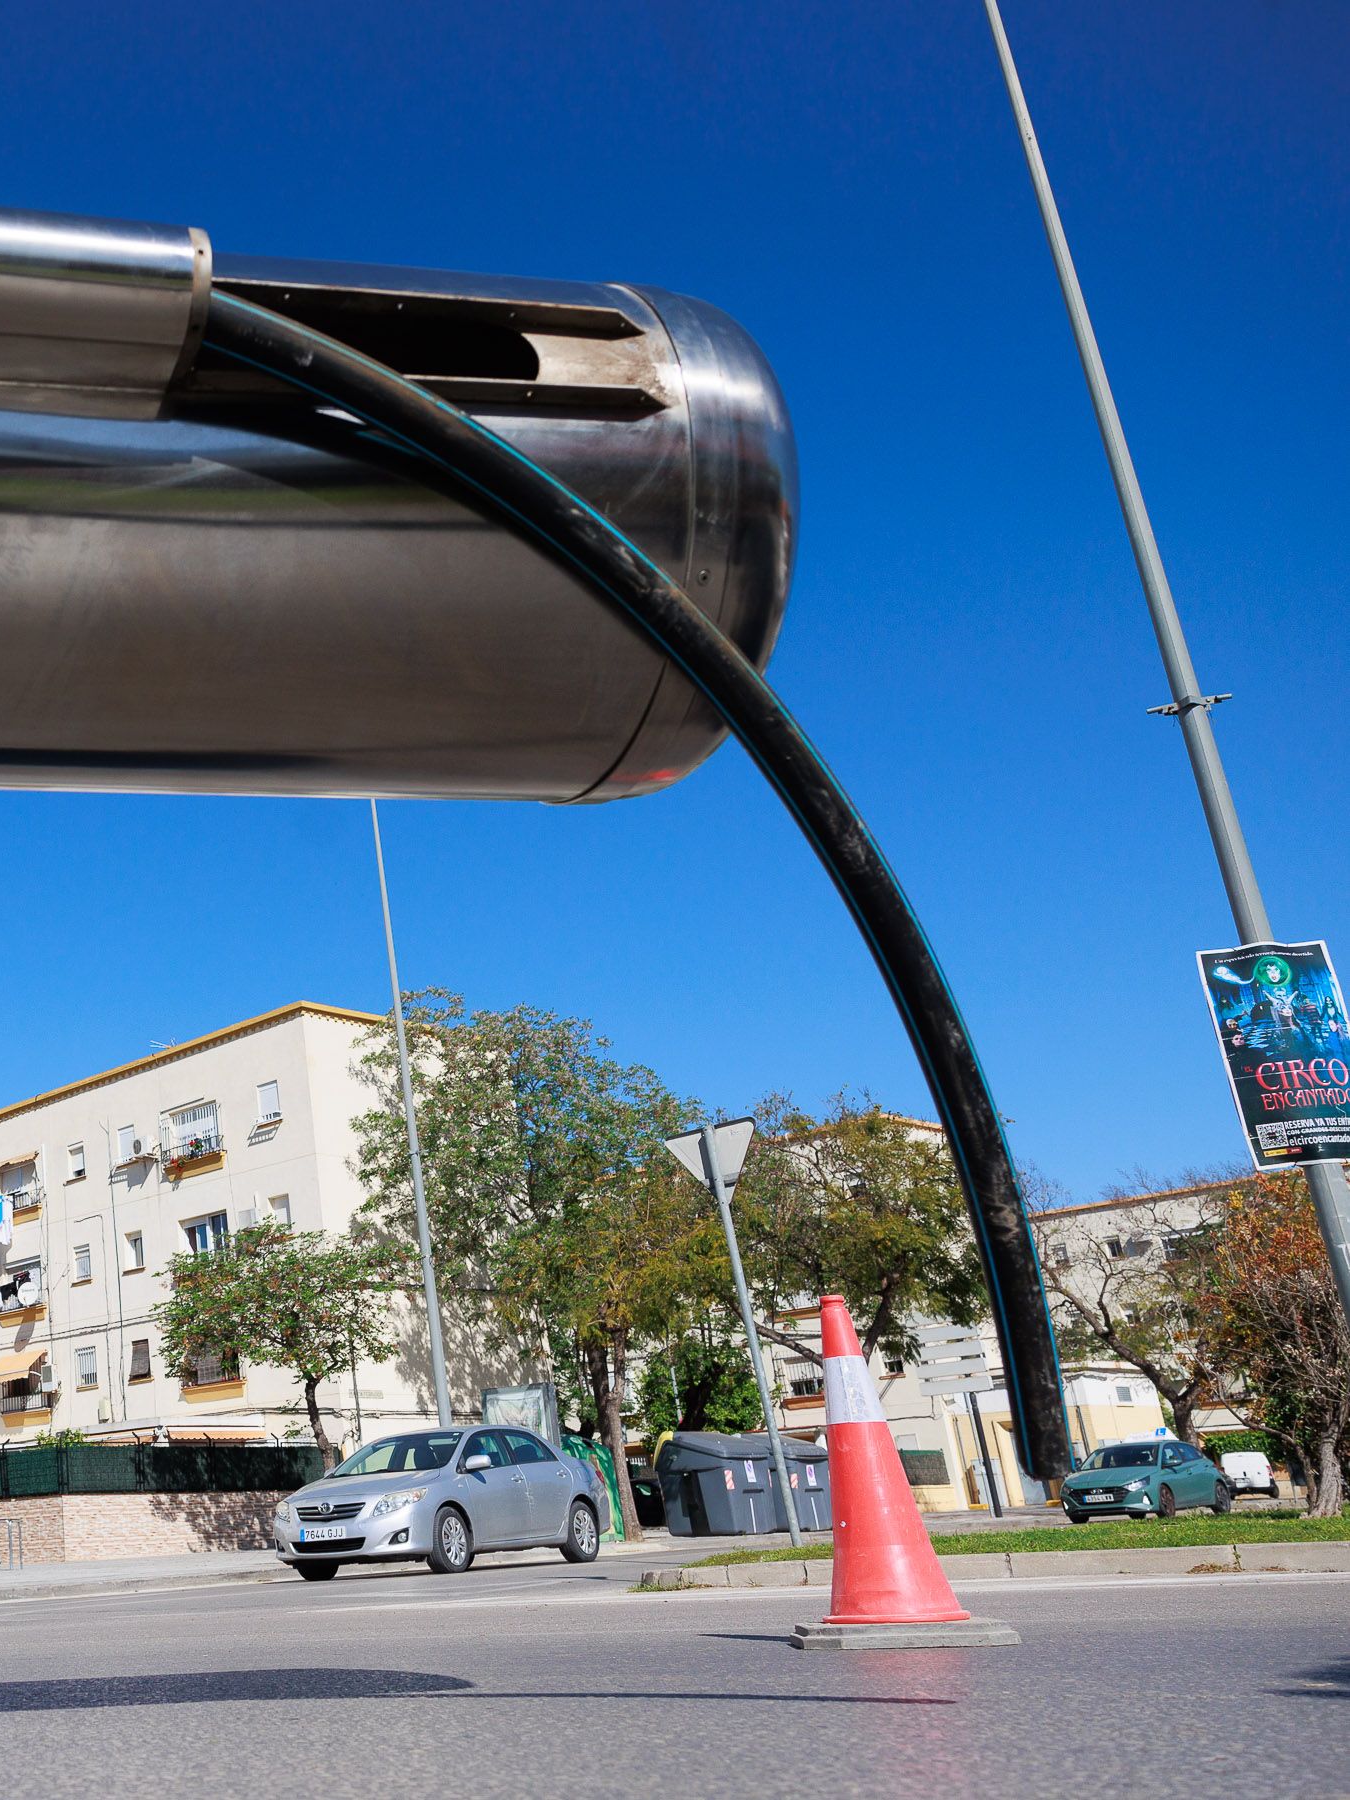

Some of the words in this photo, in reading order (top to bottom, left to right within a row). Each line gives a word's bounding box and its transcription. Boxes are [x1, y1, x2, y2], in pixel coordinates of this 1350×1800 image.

[1255, 1058, 1350, 1091] CIRCO
[1284, 1119, 1315, 1130] RESERVA
[1314, 1117, 1326, 1127] YA
[1325, 1117, 1338, 1126] TUS
[305, 1530, 325, 1539] 7644
[327, 1528, 343, 1538] GJJ
